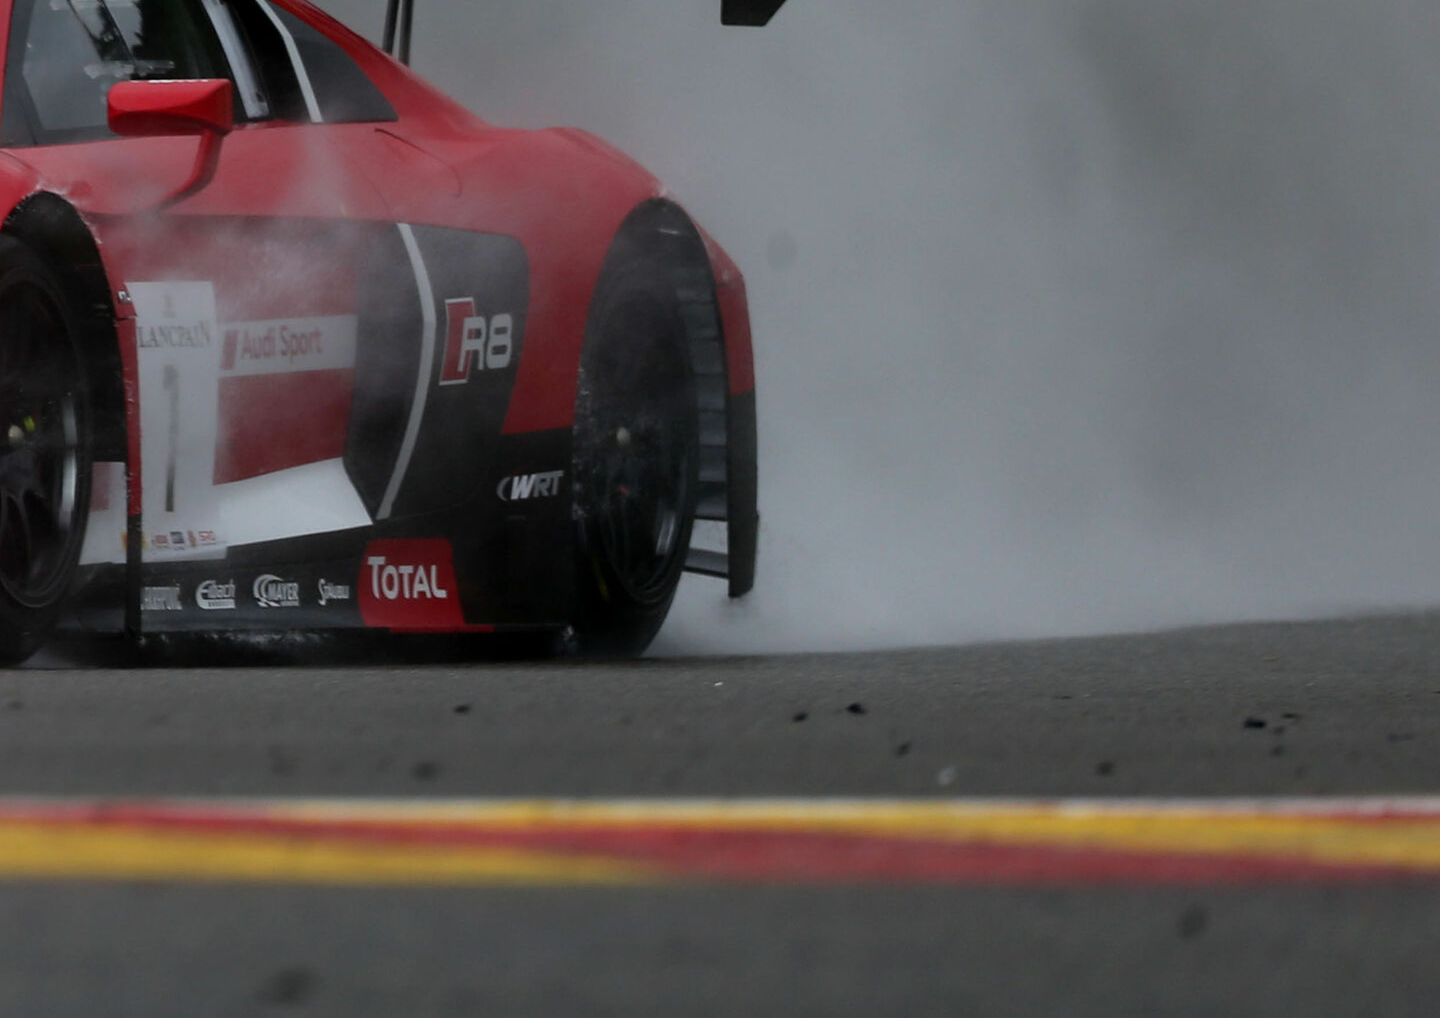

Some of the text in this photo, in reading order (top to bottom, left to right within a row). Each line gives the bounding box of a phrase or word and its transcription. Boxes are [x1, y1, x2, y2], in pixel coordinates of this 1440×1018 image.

[137, 321, 210, 349] LANCPAIN
[241, 325, 323, 364] Audi Sport
[457, 312, 513, 372] R8
[510, 470, 564, 500] WRT
[367, 555, 448, 600] TOTAL
